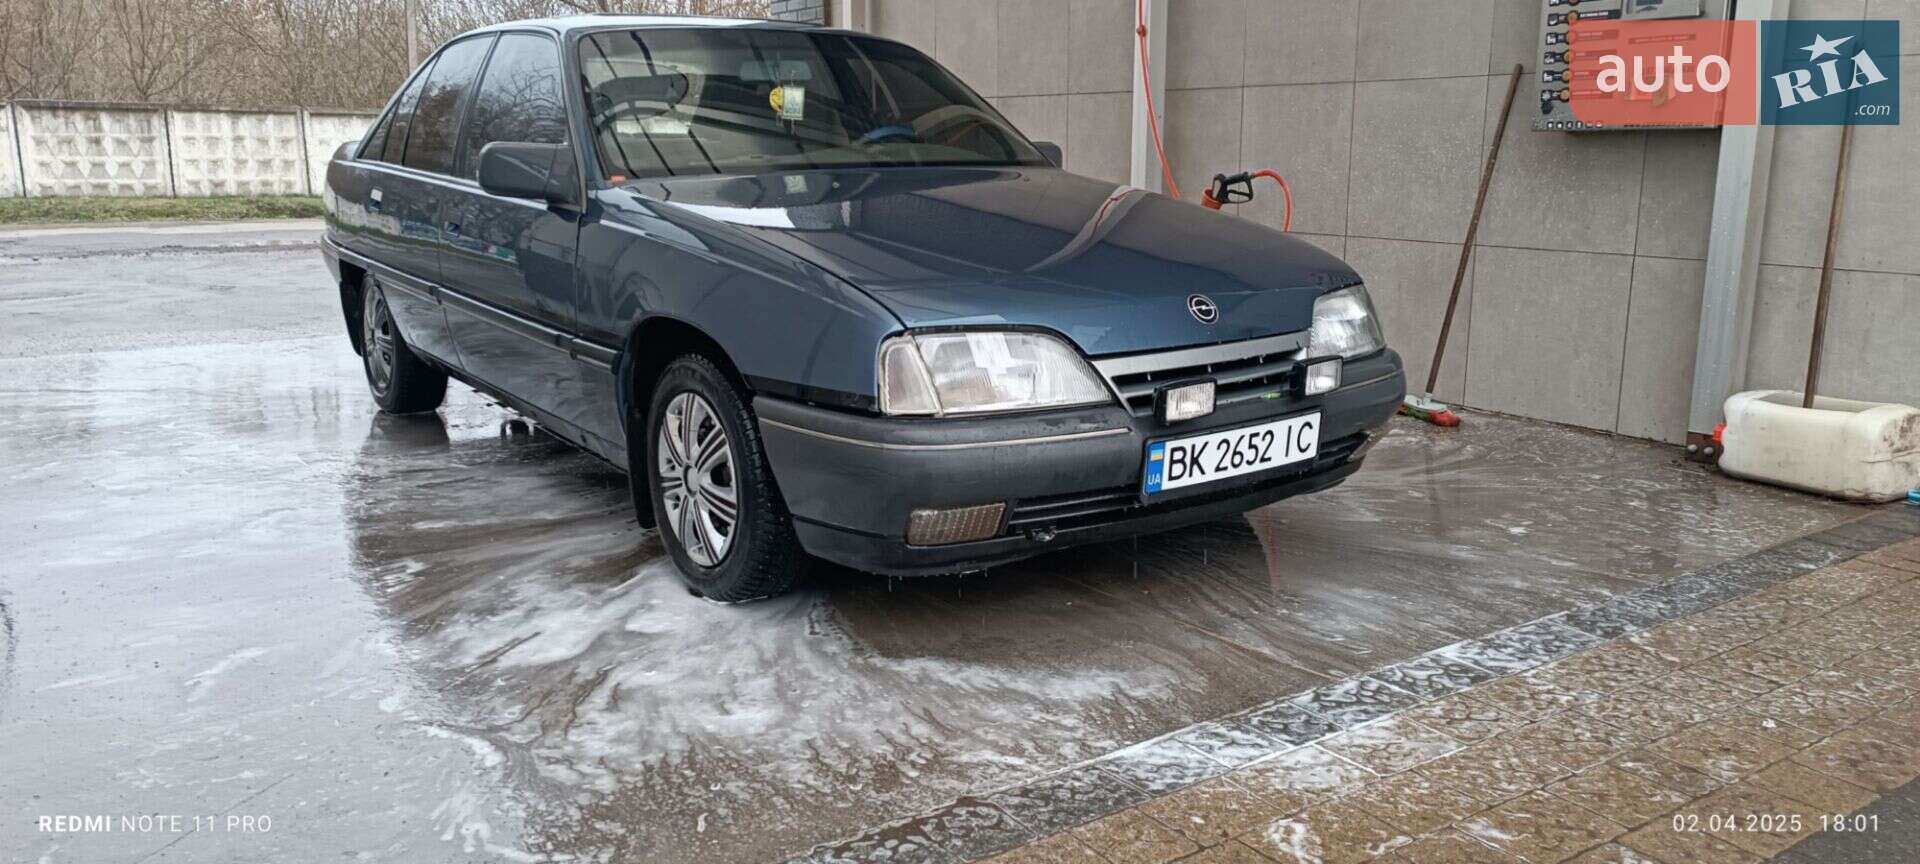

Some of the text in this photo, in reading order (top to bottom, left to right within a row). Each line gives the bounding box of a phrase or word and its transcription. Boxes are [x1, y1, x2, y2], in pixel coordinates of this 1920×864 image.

[1167, 421, 1314, 482] BK 2652 IC
[1148, 474, 1161, 486] UA
